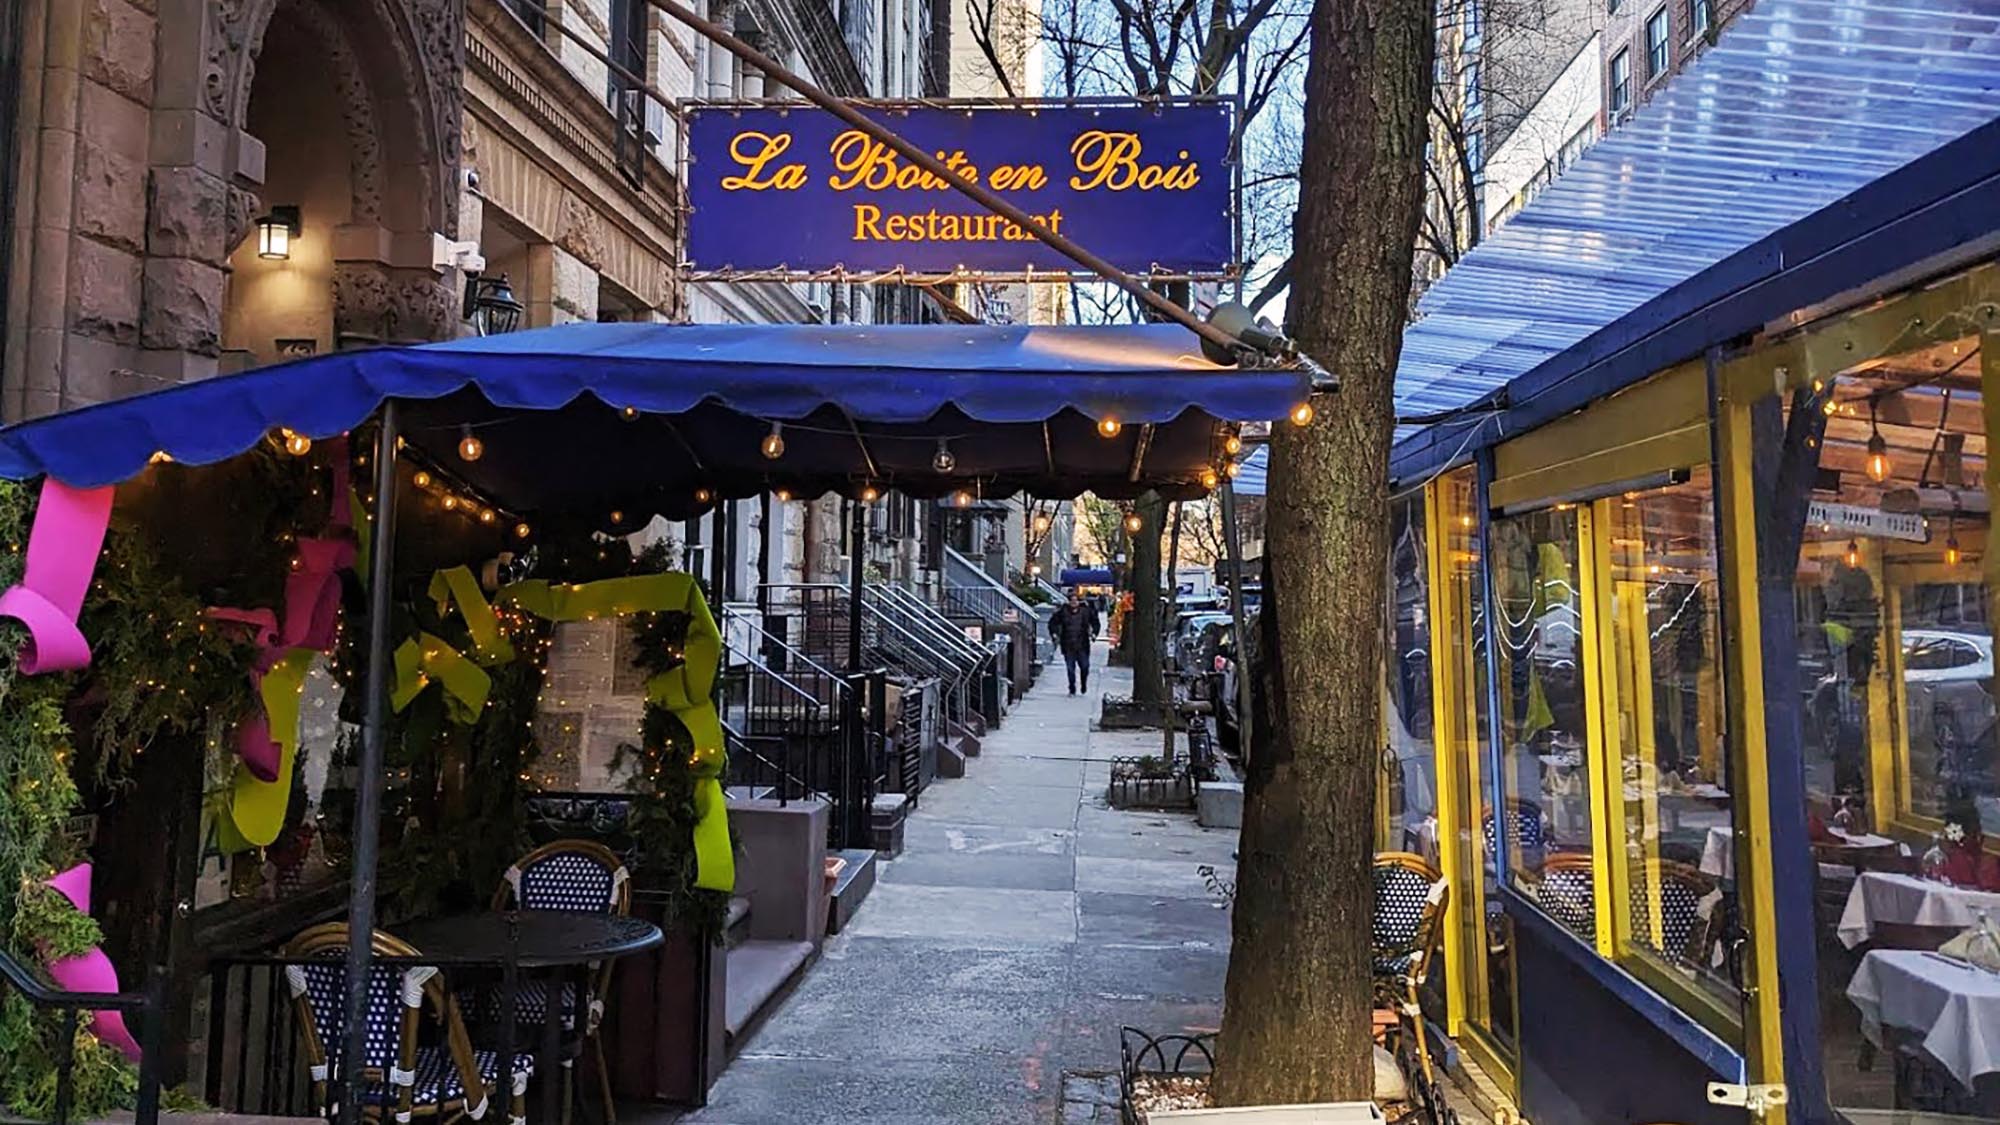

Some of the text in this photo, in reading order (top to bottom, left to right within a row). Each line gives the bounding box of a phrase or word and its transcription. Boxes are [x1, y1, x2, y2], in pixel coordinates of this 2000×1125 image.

[722, 130, 1200, 191] La Boite en Bois
